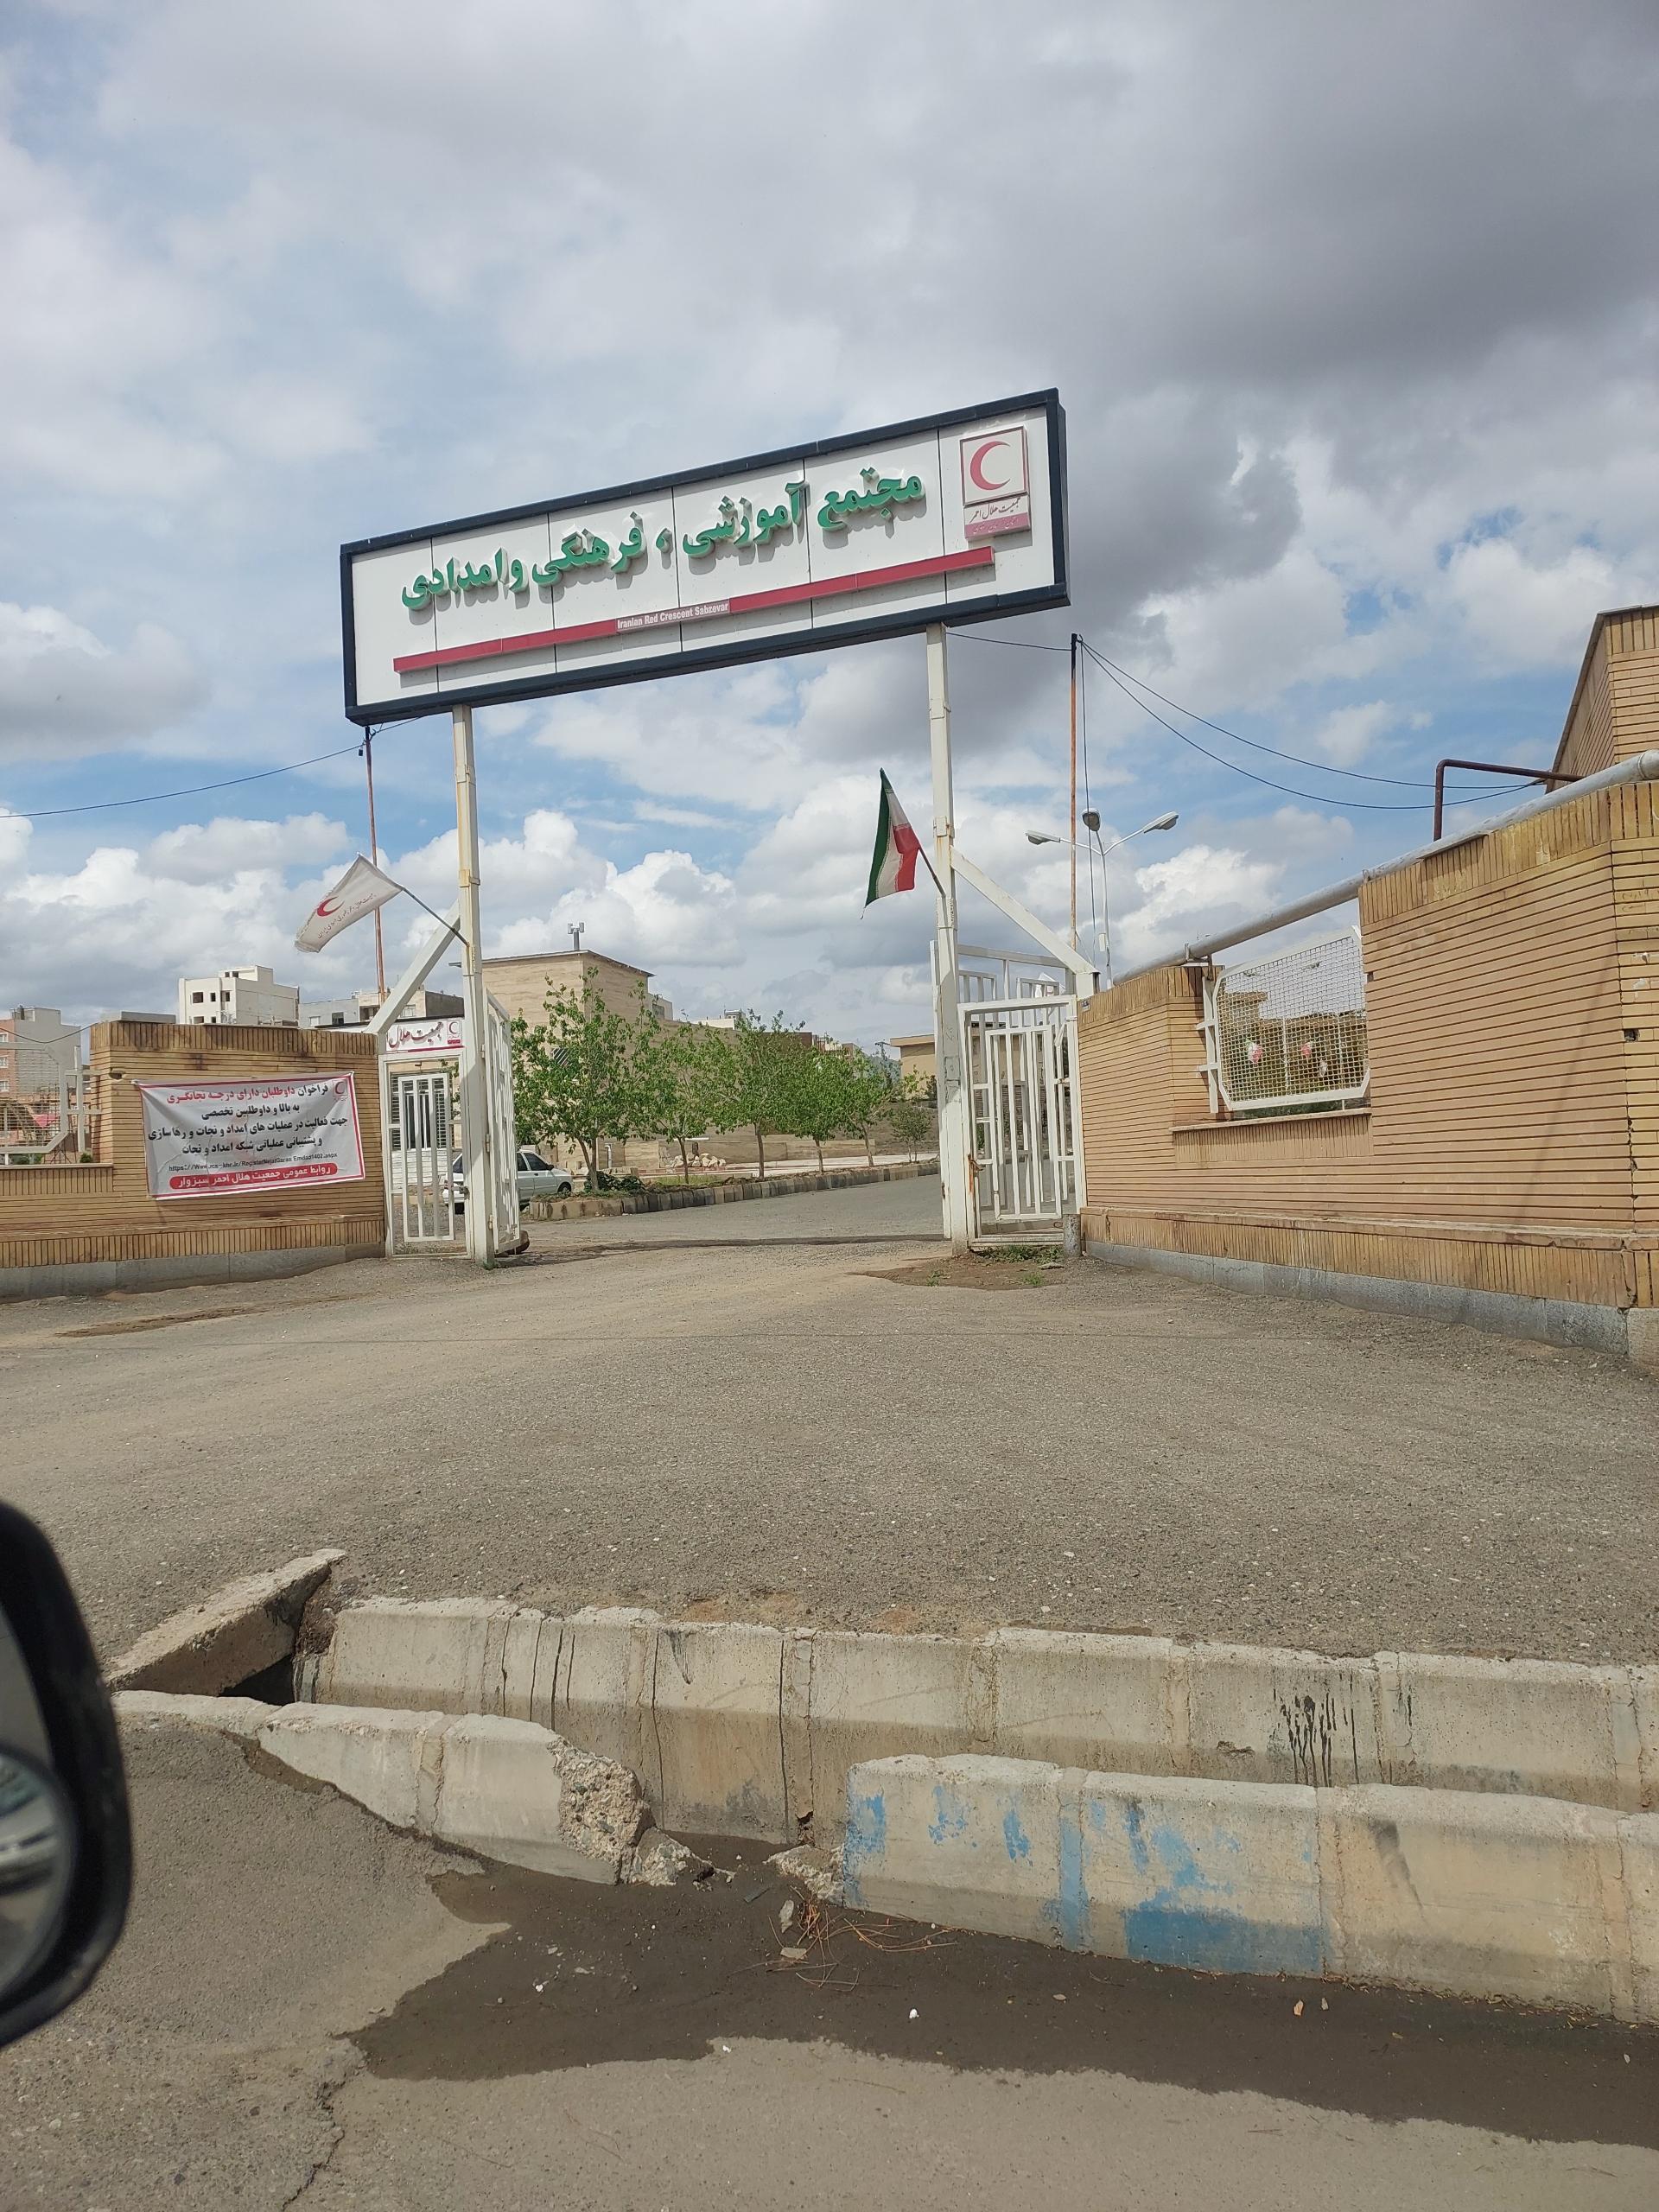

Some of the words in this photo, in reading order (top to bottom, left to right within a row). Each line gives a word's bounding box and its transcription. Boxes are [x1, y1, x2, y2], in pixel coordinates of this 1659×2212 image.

[817, 467, 925, 531] مجتمع
[683, 480, 808, 556] آموزشی
[531, 512, 645, 587] فرهنگی
[617, 617, 643, 629] Iranian
[645, 613, 658, 625] Red
[660, 608, 693, 622] Crescent
[695, 603, 728, 616] Sabzevar
[237, 1089, 259, 1100] دارای
[262, 1086, 295, 1098] داوطلبان
[298, 1084, 328, 1096] فراخوان
[201, 1107, 233, 1120] تخصصی
[236, 1105, 271, 1117] داوطلبین
[279, 1103, 290, 1114] بالا
[293, 1103, 300, 1113] به
[268, 1121, 293, 1132] عملیات
[295, 1121, 303, 1131] در
[305, 1116, 328, 1128] فعالیت
[330, 1117, 348, 1126] جهت
[196, 1125, 218, 1137] نجات
[220, 1128, 225, 1137] و
[226, 1123, 248, 1134] امداد
[250, 1122, 264, 1135] های
[189, 1130, 194, 1139] و
[212, 1142, 232, 1152] امداد
[235, 1141, 254, 1153] شبکه
[256, 1139, 284, 1151] عملیاتی
[286, 1135, 316, 1148] پشتیبانی
[318, 1137, 322, 1146] و
[182, 1143, 202, 1155] نجات
[204, 1147, 209, 1156] و
[283, 1168, 308, 1179] عمومی
[309, 1165, 331, 1174] روابط
[213, 1174, 230, 1185] احمر
[232, 1171, 251, 1183] هلال
[252, 1170, 281, 1181] جمعیت
[178, 1177, 209, 1188] سبزوار
